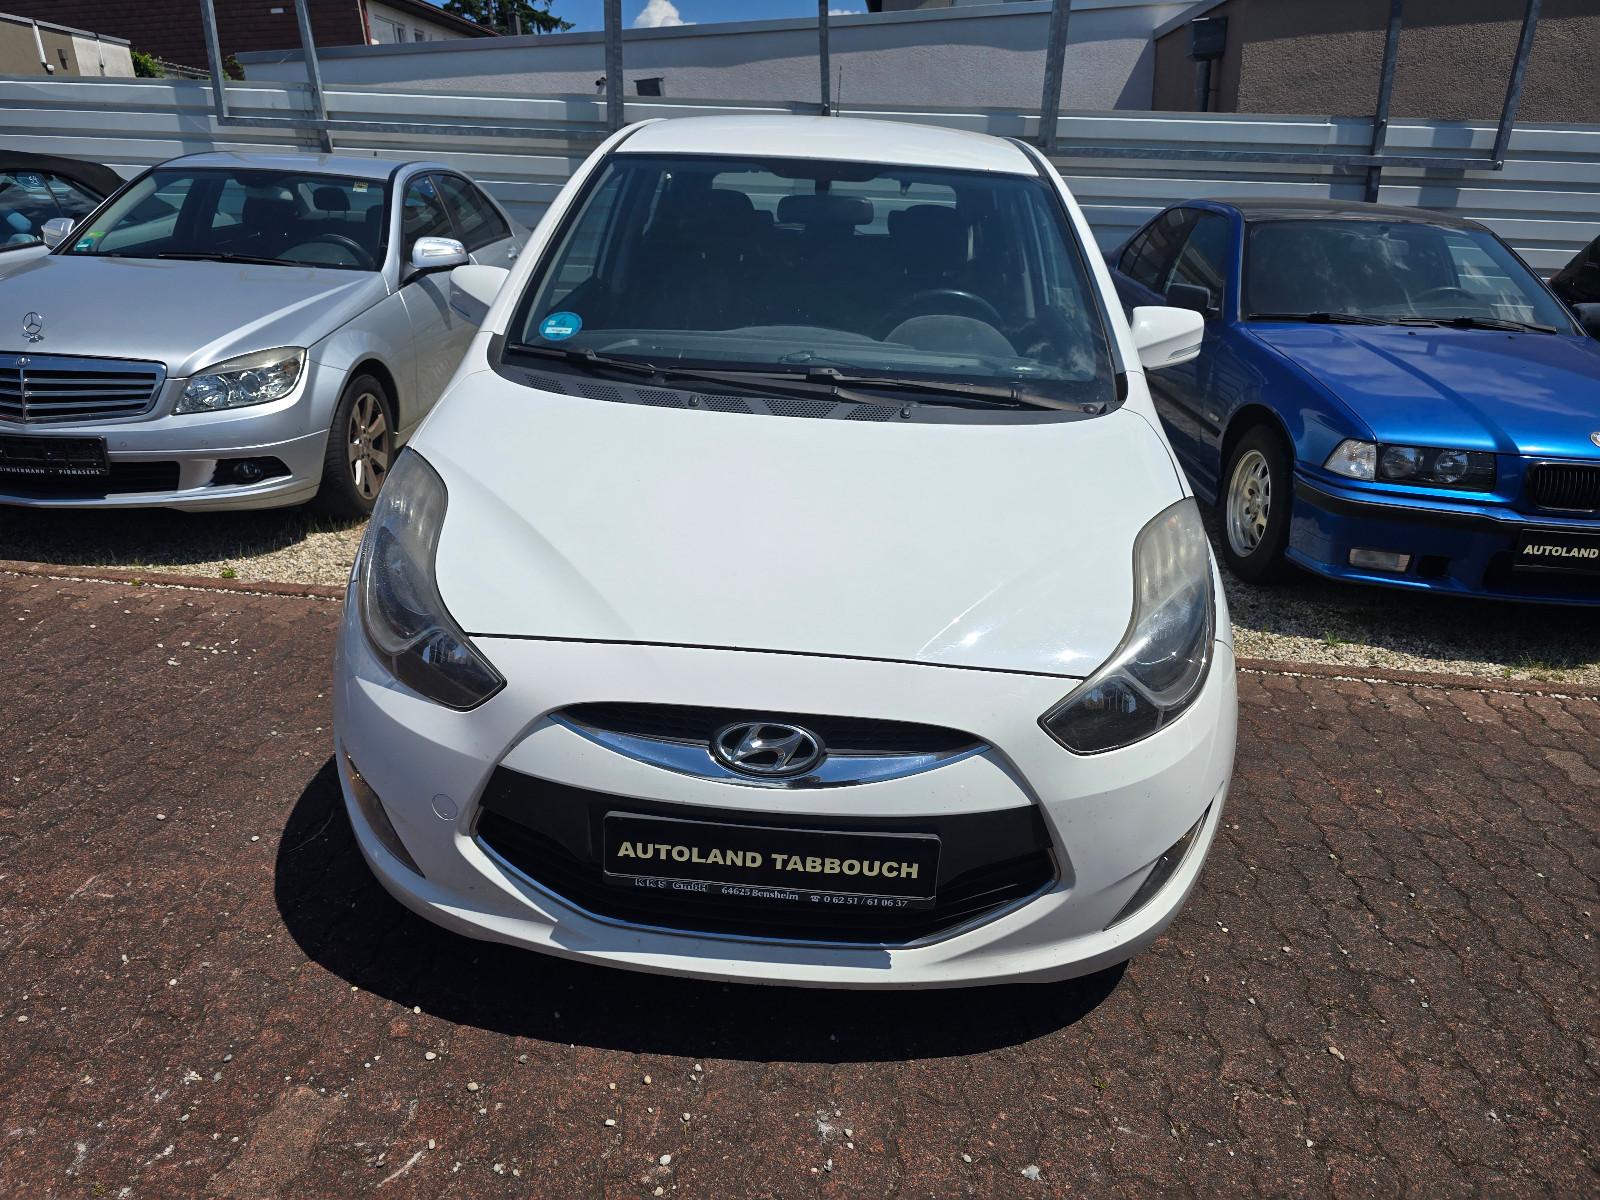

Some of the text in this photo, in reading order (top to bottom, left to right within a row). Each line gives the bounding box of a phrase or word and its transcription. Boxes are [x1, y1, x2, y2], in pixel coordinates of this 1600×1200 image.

[1522, 544, 1599, 559] AUTOLAND
[617, 841, 919, 879] AUTOLAND TABBOUCH
[671, 881, 708, 893] GmbH
[721, 886, 750, 897] 64625
[751, 888, 799, 901] Bensheim
